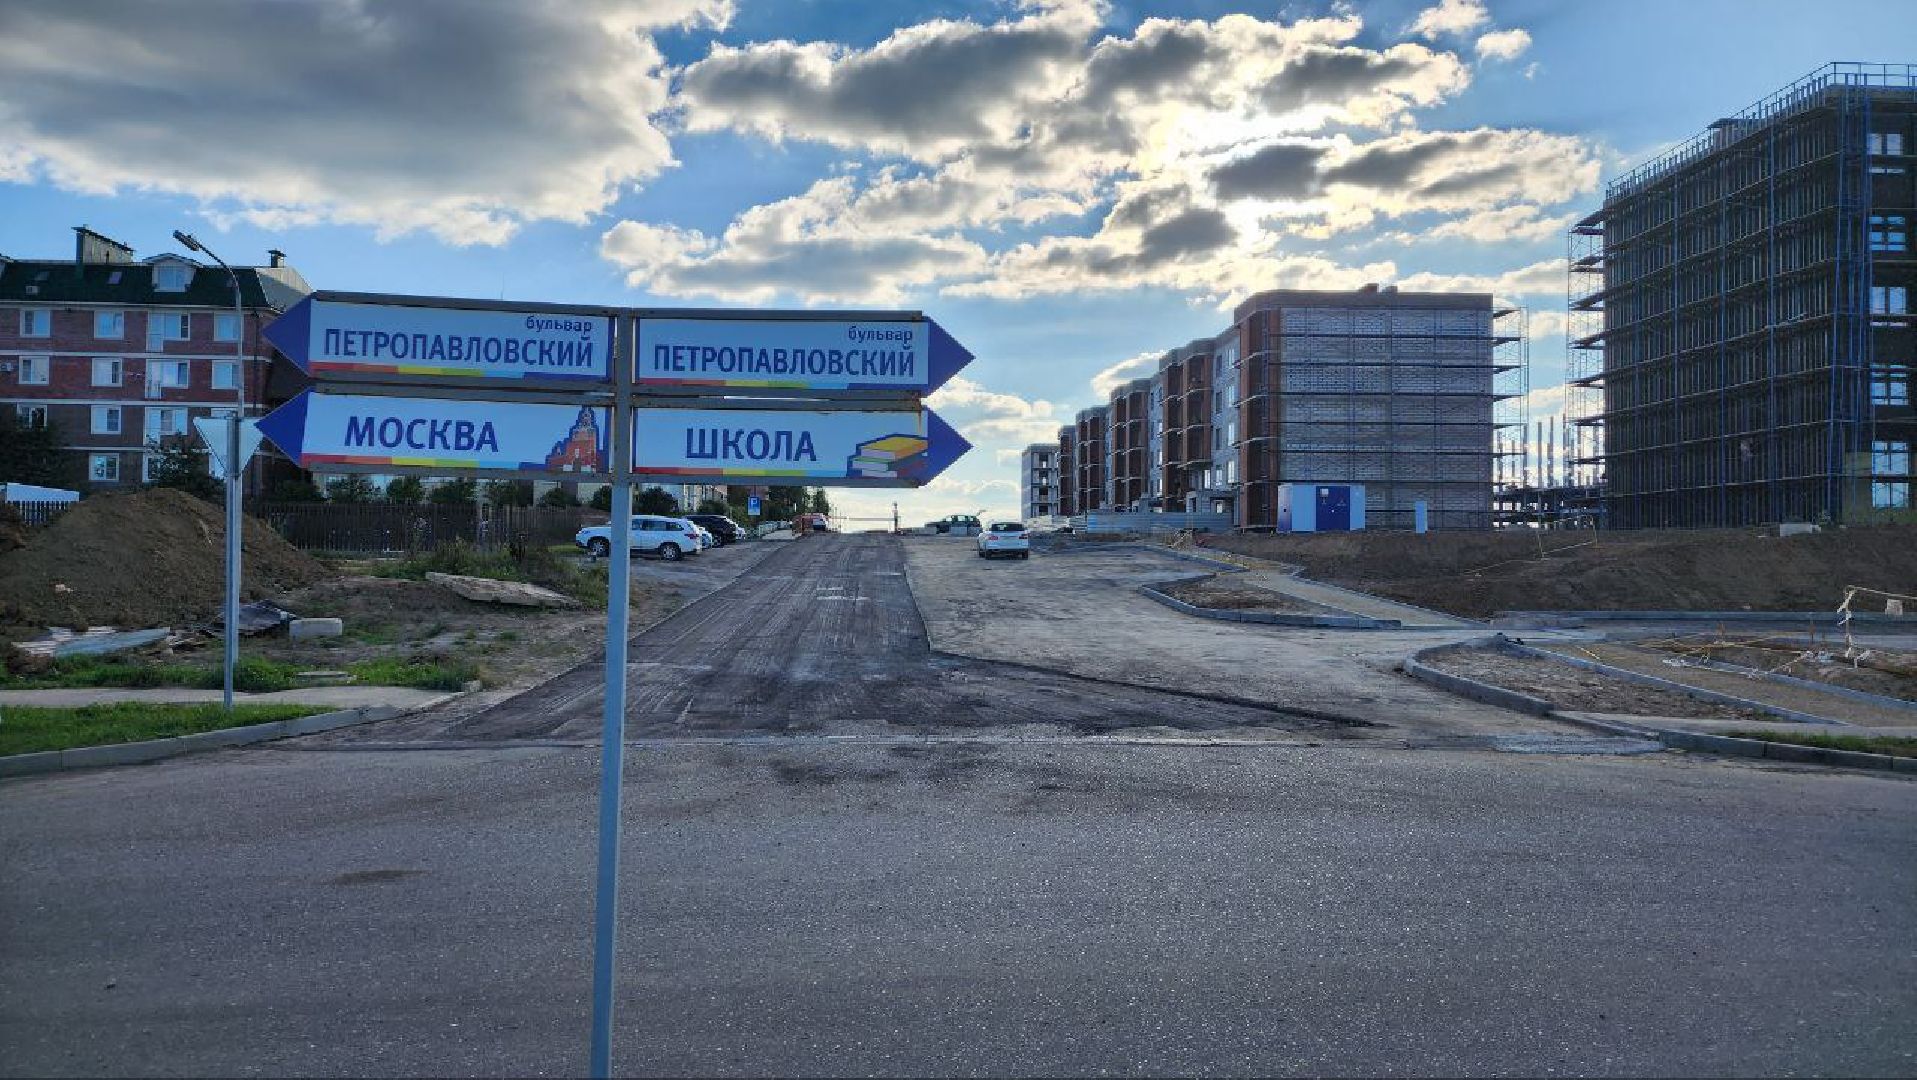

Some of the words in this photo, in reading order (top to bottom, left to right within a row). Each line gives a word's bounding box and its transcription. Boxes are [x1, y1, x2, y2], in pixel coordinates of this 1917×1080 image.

[526, 316, 592, 333] бульвар
[848, 325, 913, 343] бульвар
[325, 328, 592, 367] ПЕТРОПАВЛОВСКИЙ
[654, 344, 914, 377] ПЕТРОПАВЛОВСКИЙ
[344, 416, 499, 453] МОСКВА
[685, 428, 817, 462] ШКОЛА
